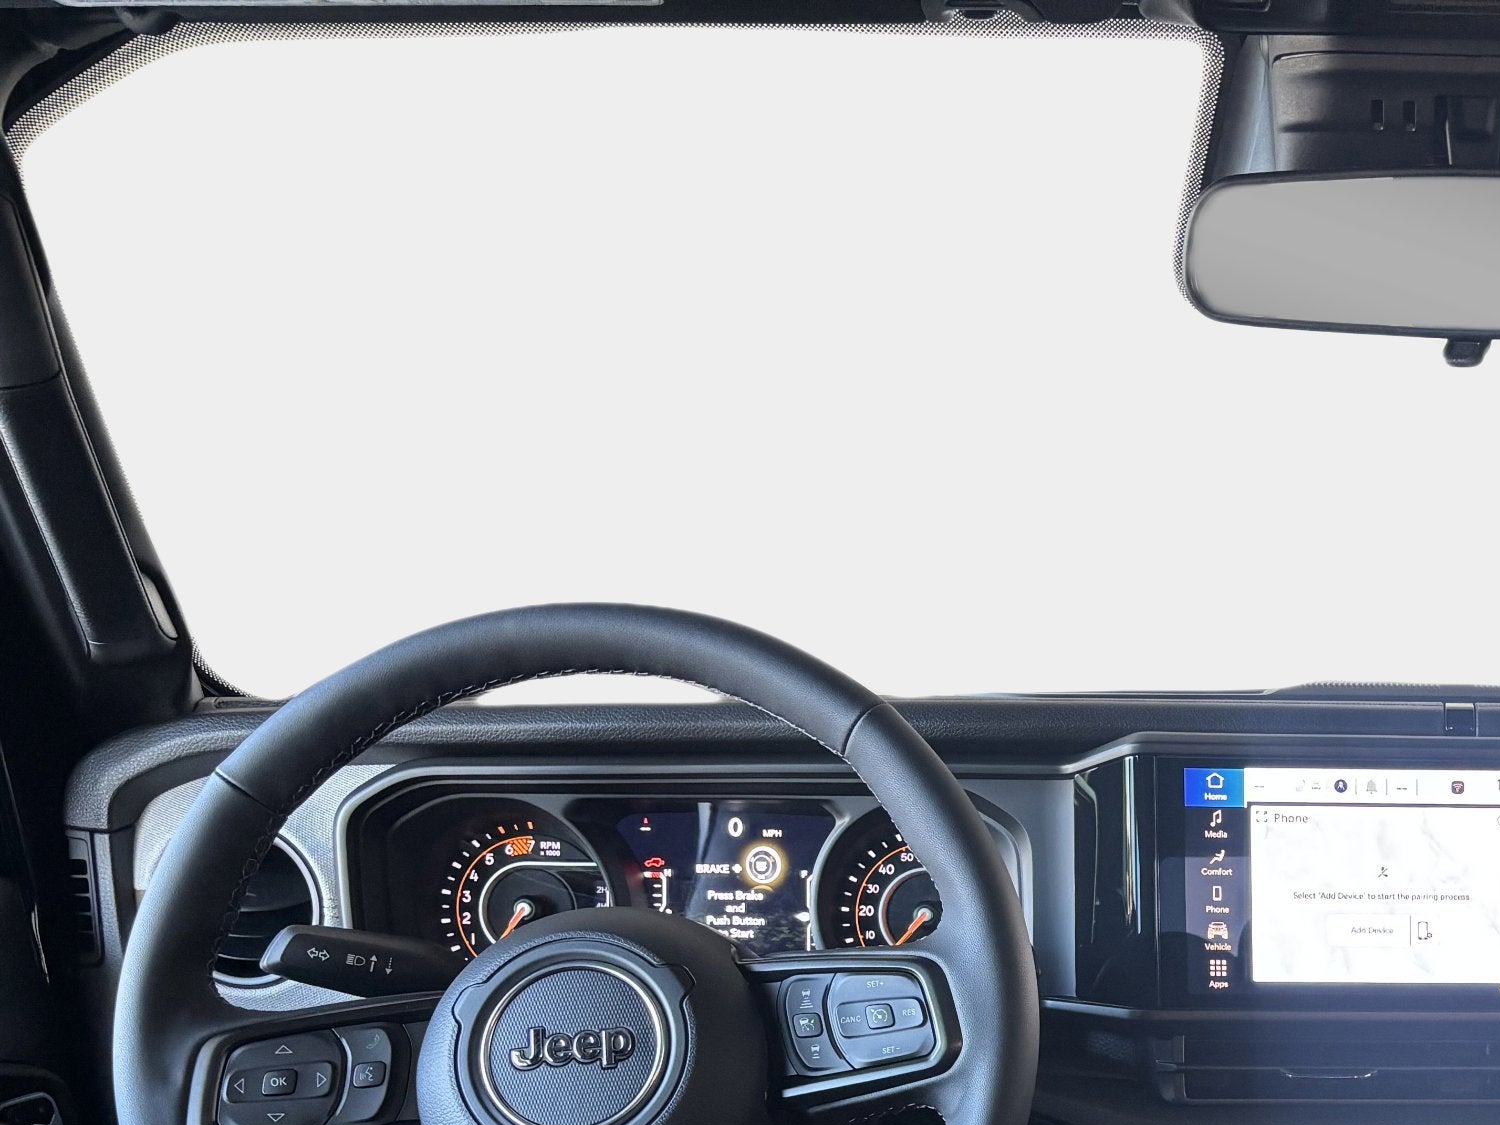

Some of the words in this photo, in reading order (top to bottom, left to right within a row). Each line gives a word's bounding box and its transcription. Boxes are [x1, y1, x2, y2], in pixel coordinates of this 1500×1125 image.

[1204, 793, 1227, 801] Home
[1274, 813, 1309, 823] Phone
[728, 817, 743, 837] 0
[762, 829, 782, 837] MPH
[1205, 830, 1228, 839] Media
[505, 844, 513, 856] 6
[528, 840, 536, 854] 7
[540, 842, 560, 850] RPM
[485, 853, 494, 865] 5
[900, 853, 914, 861] 50
[695, 864, 730, 874] BRAKE
[878, 864, 895, 875] 40
[1201, 868, 1233, 876] Comfort
[470, 870, 479, 881] 4
[866, 884, 879, 894] 30
[462, 890, 471, 902] 3
[707, 890, 734, 900] Press
[735, 890, 764, 900] Brake
[1293, 892, 1316, 900] Select
[1377, 893, 1395, 901] start
[1397, 893, 1410, 901] the
[725, 903, 746, 913] and
[859, 905, 875, 917] 20
[1205, 906, 1229, 914] Phone
[462, 912, 471, 925] 2
[706, 915, 731, 926] Push
[732, 915, 766, 926] Button
[730, 928, 754, 939] Start
[865, 930, 875, 940] 10
[1204, 943, 1232, 951] Vehicle
[1209, 980, 1228, 989] Apps
[902, 1008, 916, 1016] RES
[840, 1015, 862, 1024] CANC
[510, 1026, 636, 1070] Jeep
[270, 1076, 287, 1088] OK
